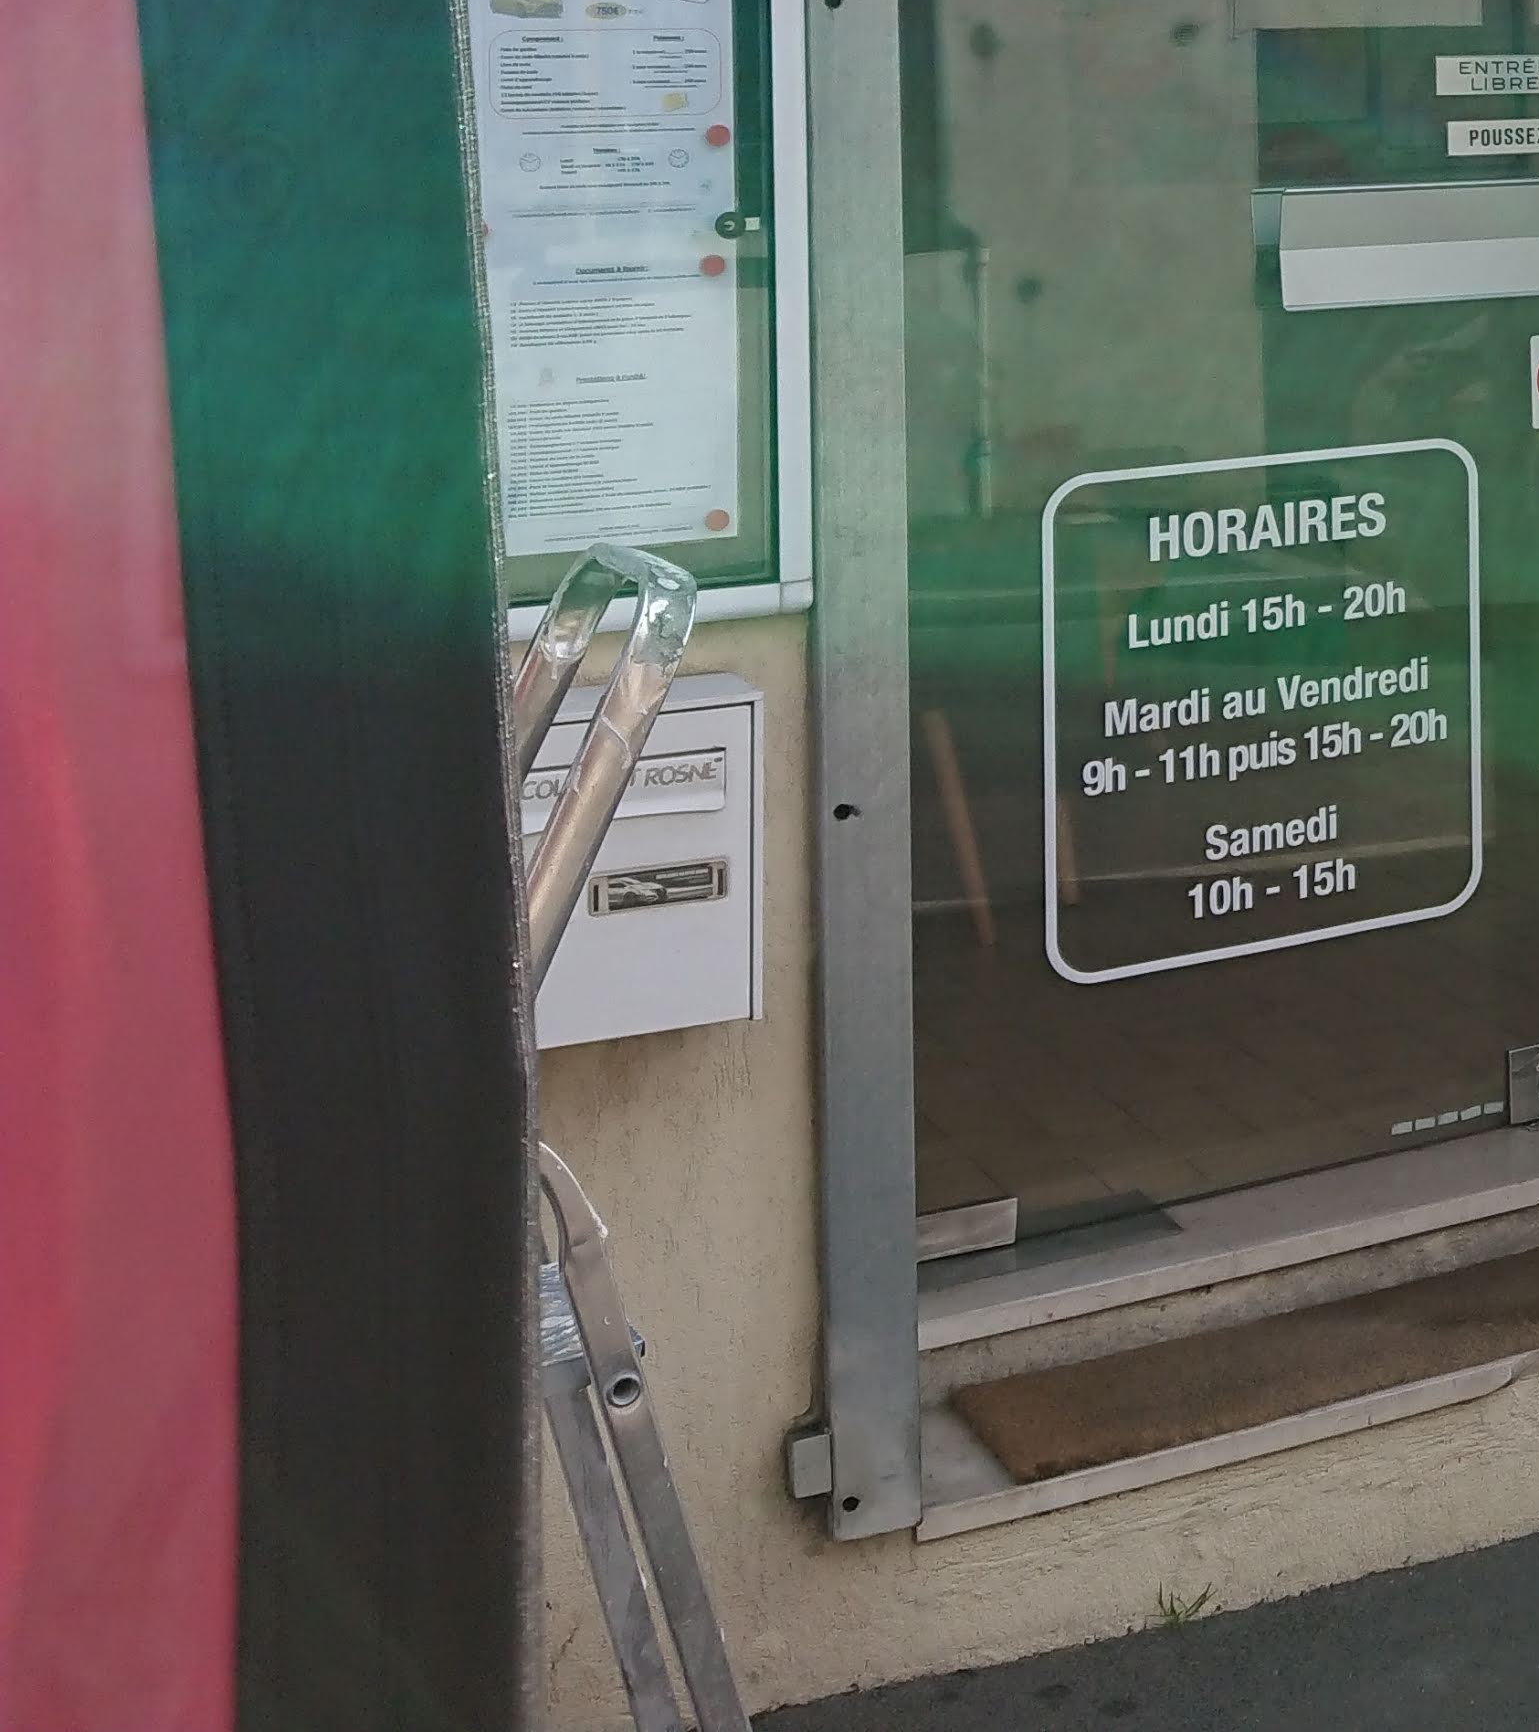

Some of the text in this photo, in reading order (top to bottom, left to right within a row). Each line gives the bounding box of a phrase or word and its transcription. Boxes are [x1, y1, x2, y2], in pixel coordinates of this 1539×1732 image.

[1471, 76, 1539, 92] LIBRE
[1149, 492, 1387, 562] HORAIRES
[1128, 601, 1230, 649] Lundi
[1242, 595, 1306, 635] 15h
[1343, 581, 1406, 621] 20h
[1104, 656, 1429, 737] Mardi au Vendredi
[644, 762, 716, 787] ROSNE
[1082, 756, 1126, 797] 9h
[1159, 744, 1220, 784] 11h
[1228, 732, 1296, 782] puis
[1303, 724, 1361, 763] 15h
[1390, 709, 1447, 748] 20h
[1205, 804, 1338, 861] Samedi
[1187, 877, 1253, 919] 10h
[1293, 860, 1356, 900] 15h
